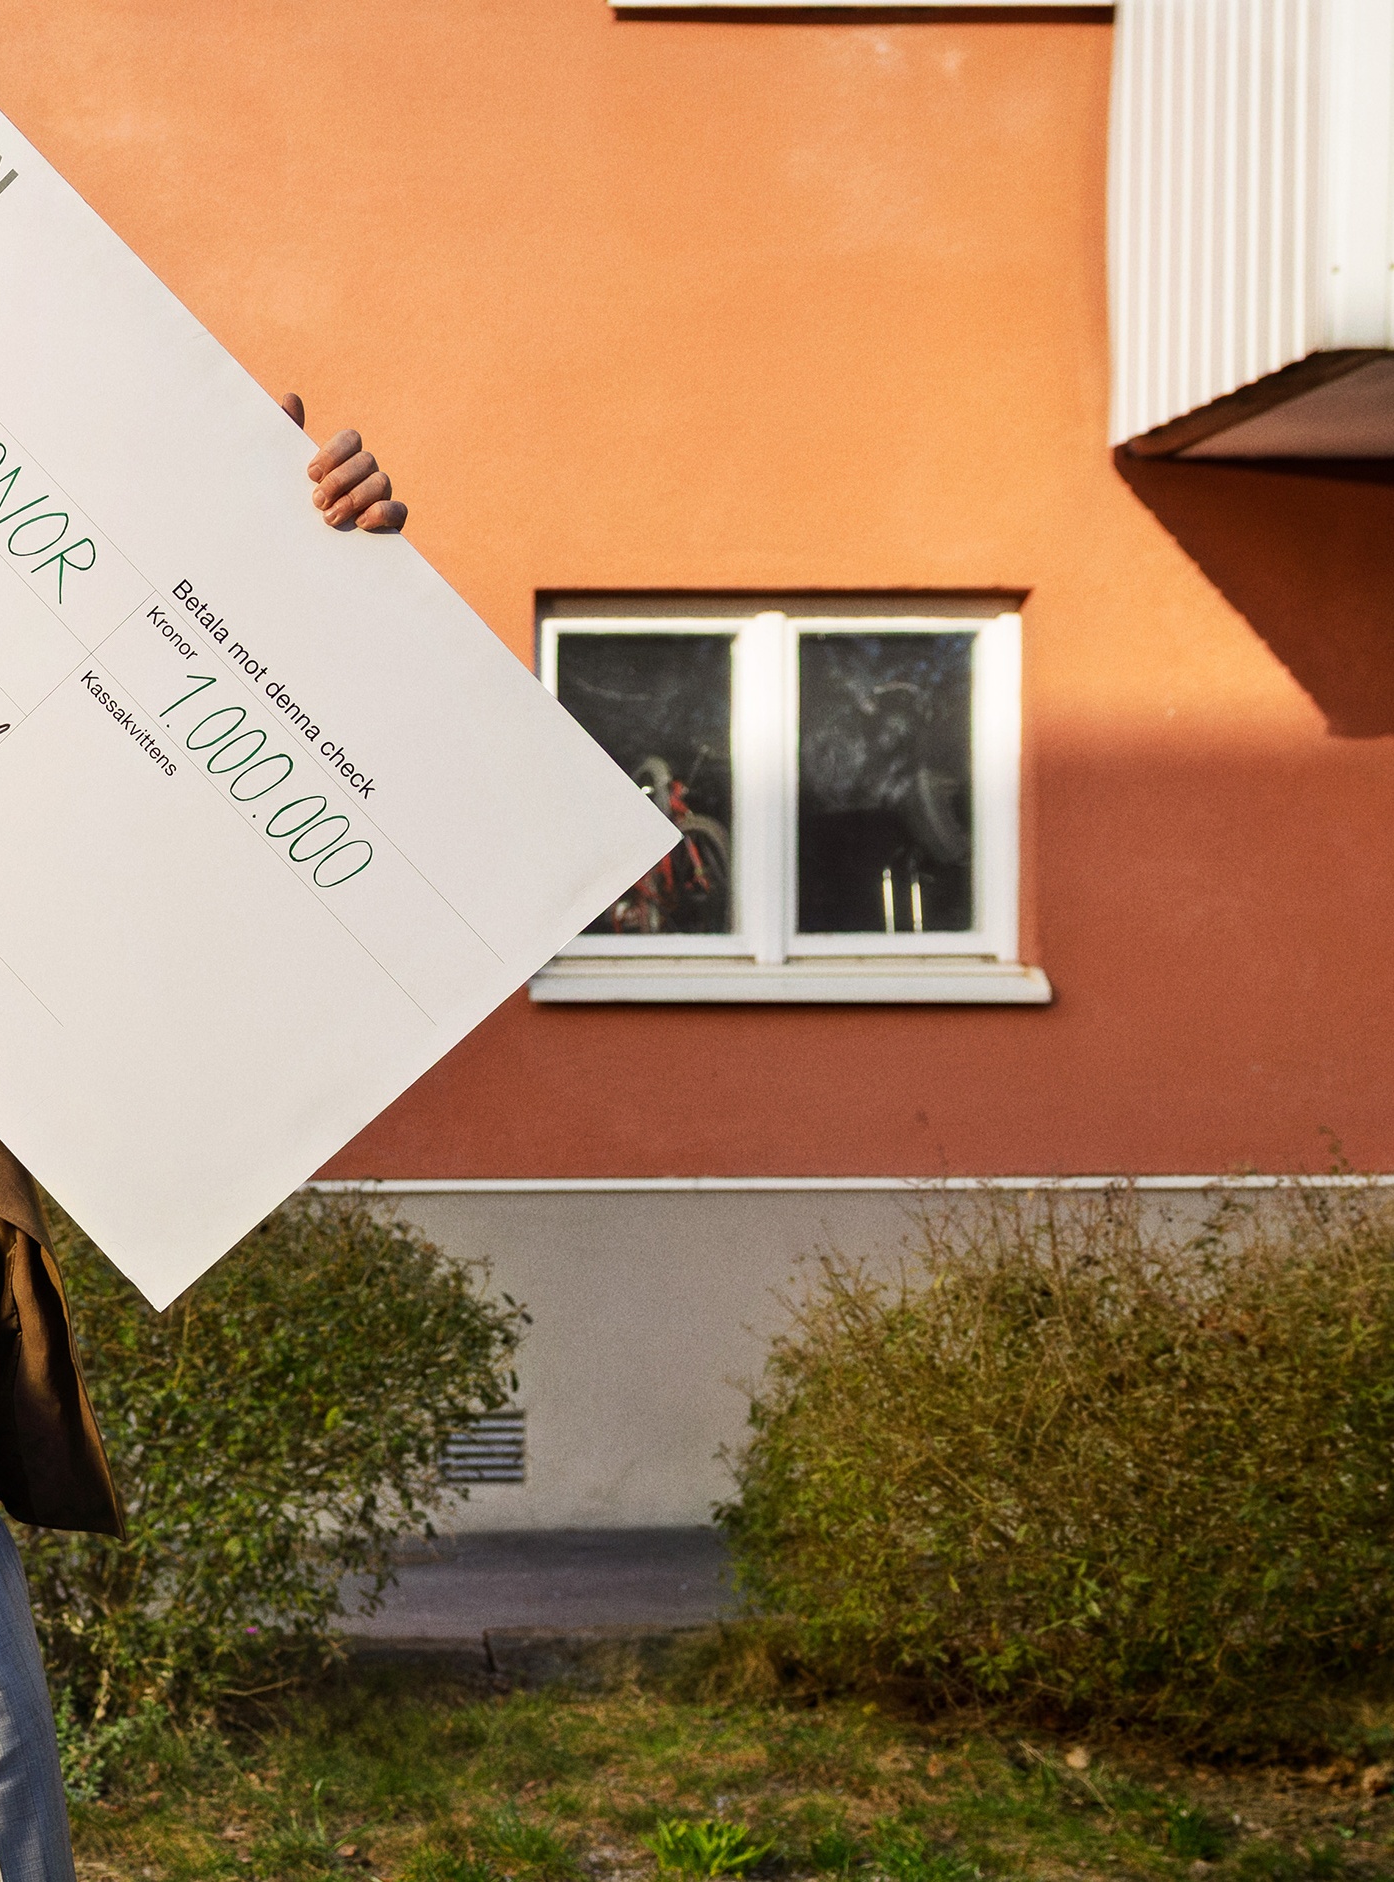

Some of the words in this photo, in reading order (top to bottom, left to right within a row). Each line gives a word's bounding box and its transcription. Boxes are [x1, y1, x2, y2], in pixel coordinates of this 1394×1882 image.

[146, 605, 199, 660] Kronor
[171, 578, 229, 645] Betala
[227, 642, 268, 683] mot
[265, 682, 321, 743] denna
[320, 735, 376, 800] check
[80, 669, 178, 777] Kassakvittens
[159, 674, 373, 888] 1.000.000
